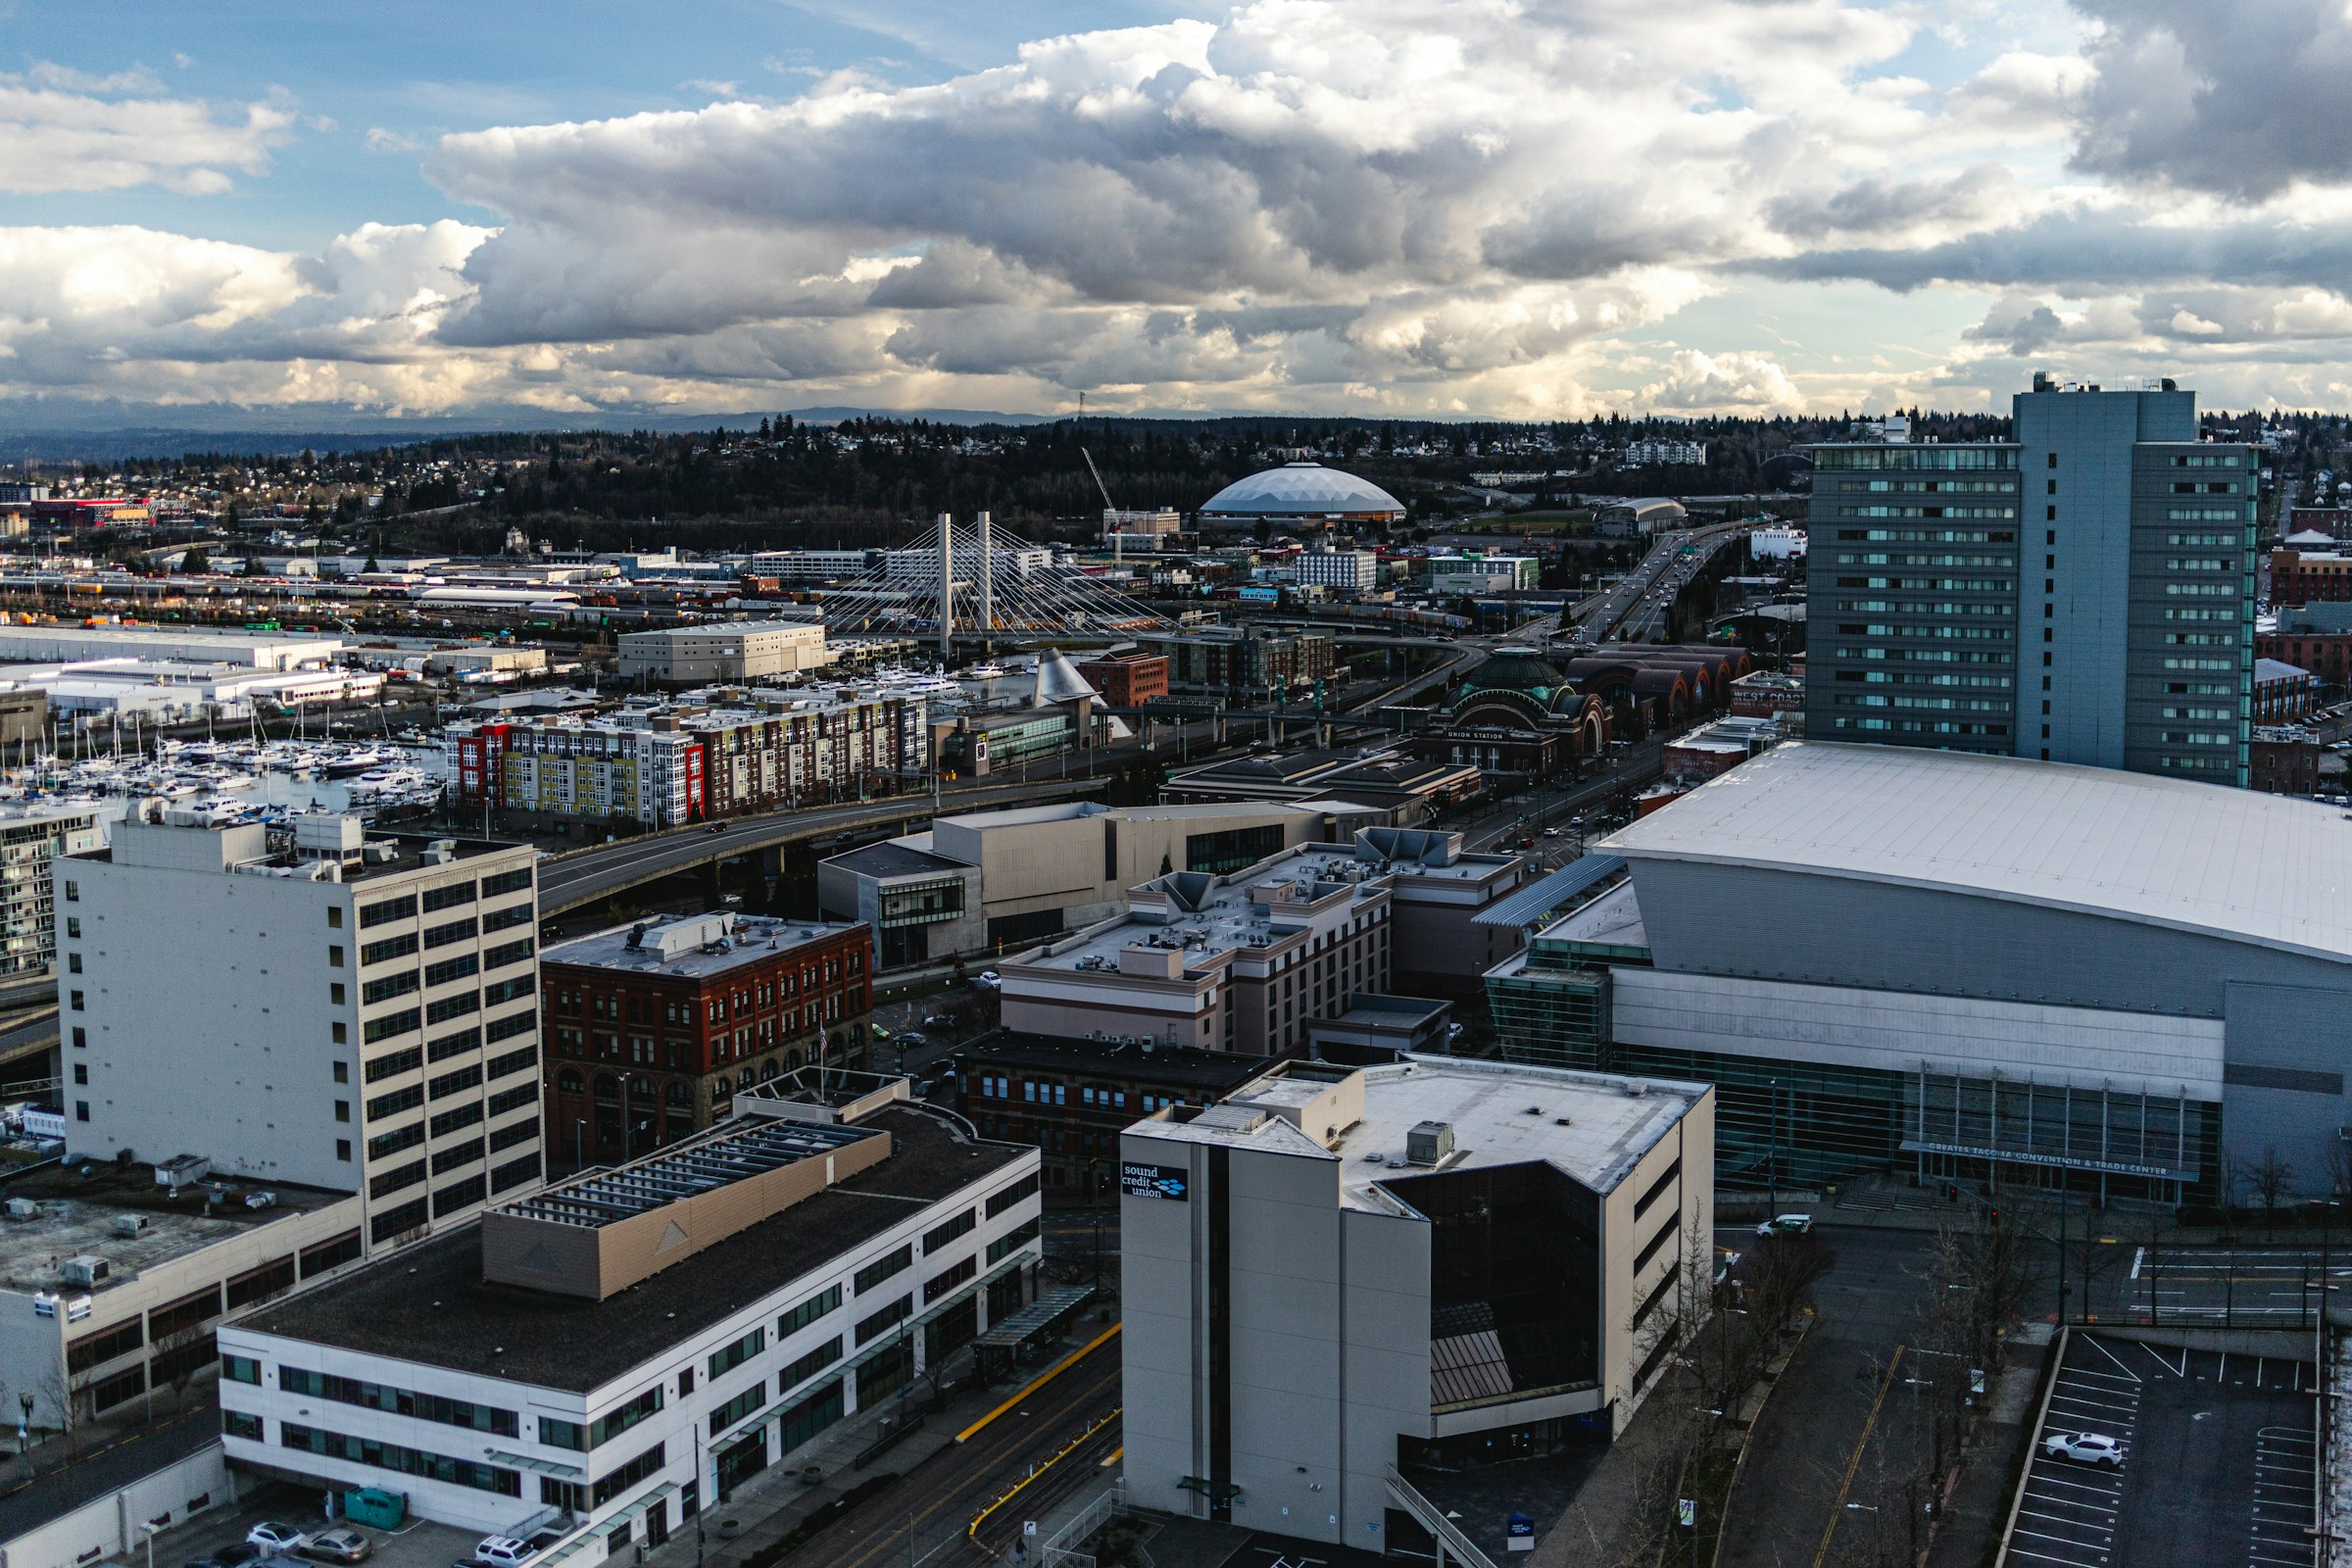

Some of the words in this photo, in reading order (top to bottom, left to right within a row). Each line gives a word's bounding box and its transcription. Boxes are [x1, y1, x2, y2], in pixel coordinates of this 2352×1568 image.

[1734, 691, 1765, 702] WEST
[1929, 1142, 1970, 1153] GREATER
[1973, 1147, 2012, 1158] TACOMA
[2015, 1152, 2081, 1166] CONVENTION
[2084, 1158, 2091, 1167] &
[2095, 1160, 2127, 1171] TRADE
[2130, 1164, 2167, 1176] CENTER
[1124, 1165, 1158, 1178] sound
[1122, 1176, 1151, 1187] credit
[1132, 1187, 1162, 1199] union
